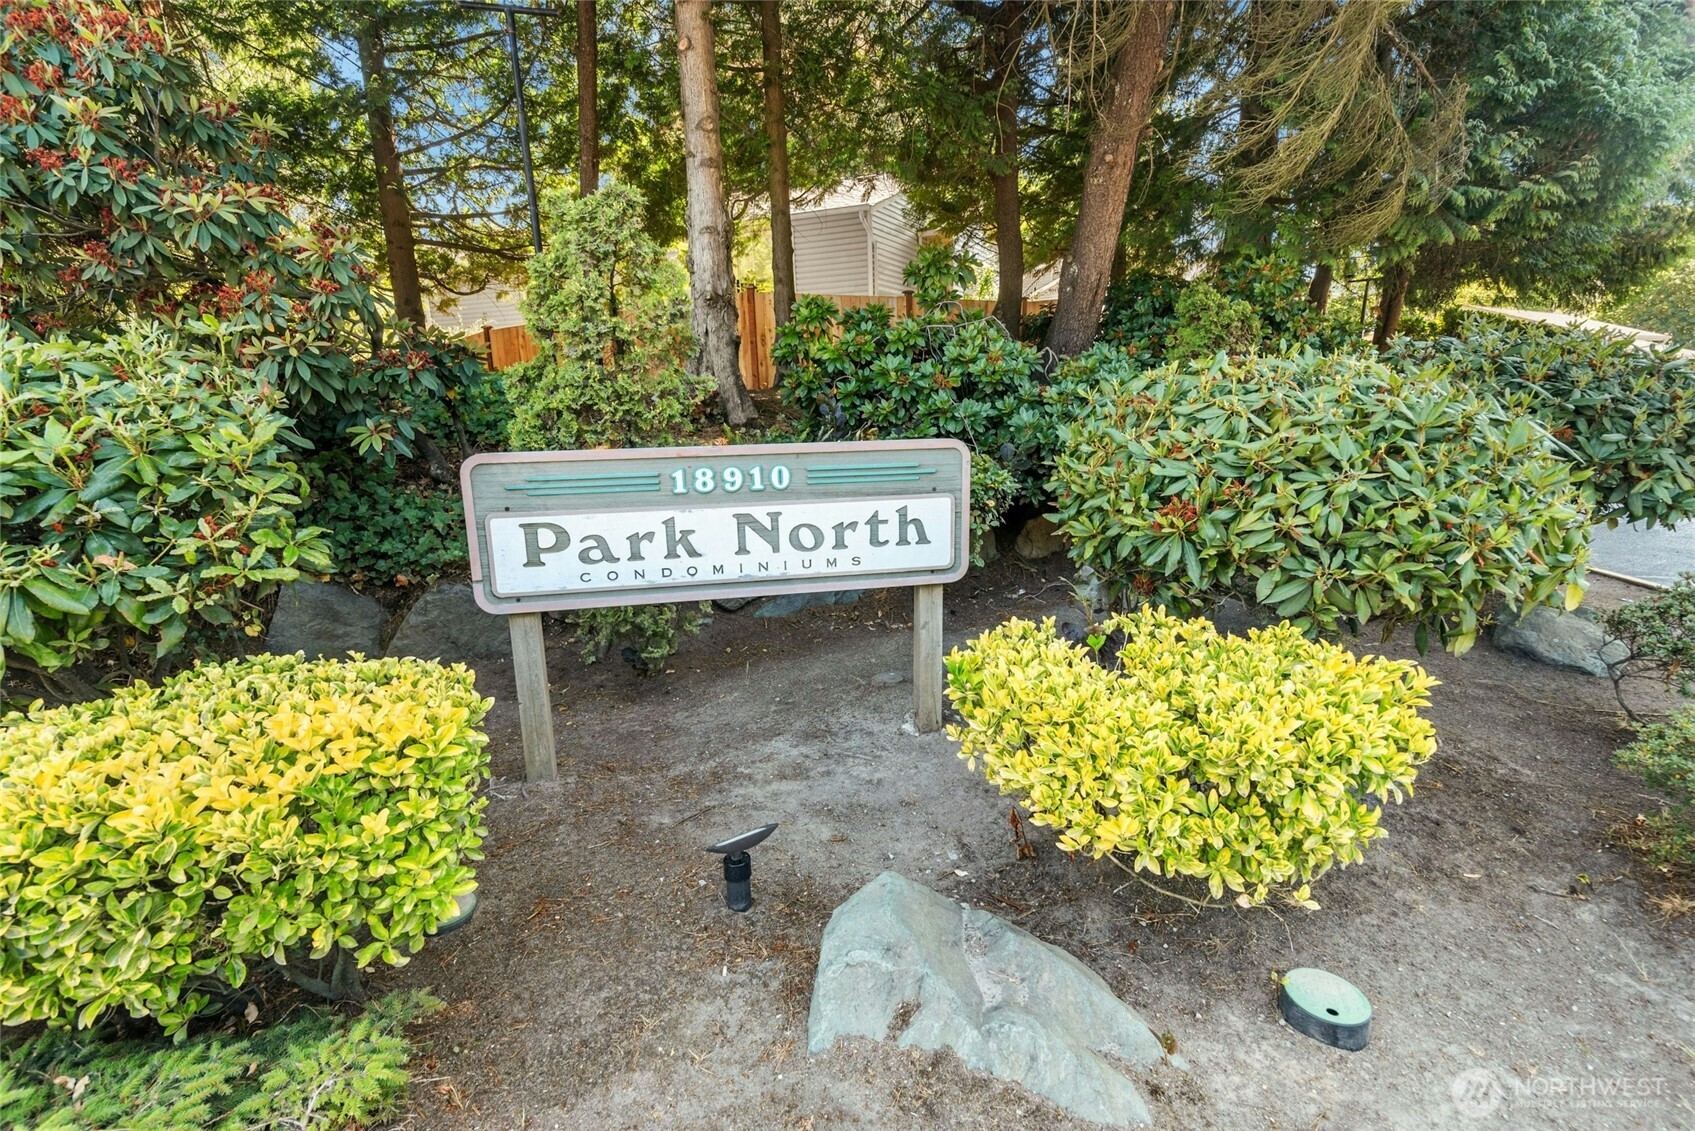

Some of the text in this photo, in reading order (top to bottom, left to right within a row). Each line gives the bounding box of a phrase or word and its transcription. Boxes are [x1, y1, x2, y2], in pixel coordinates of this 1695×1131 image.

[670, 464, 791, 495] 18910
[518, 505, 931, 568] Park North
[579, 556, 862, 583] CONDOMINIUMS
